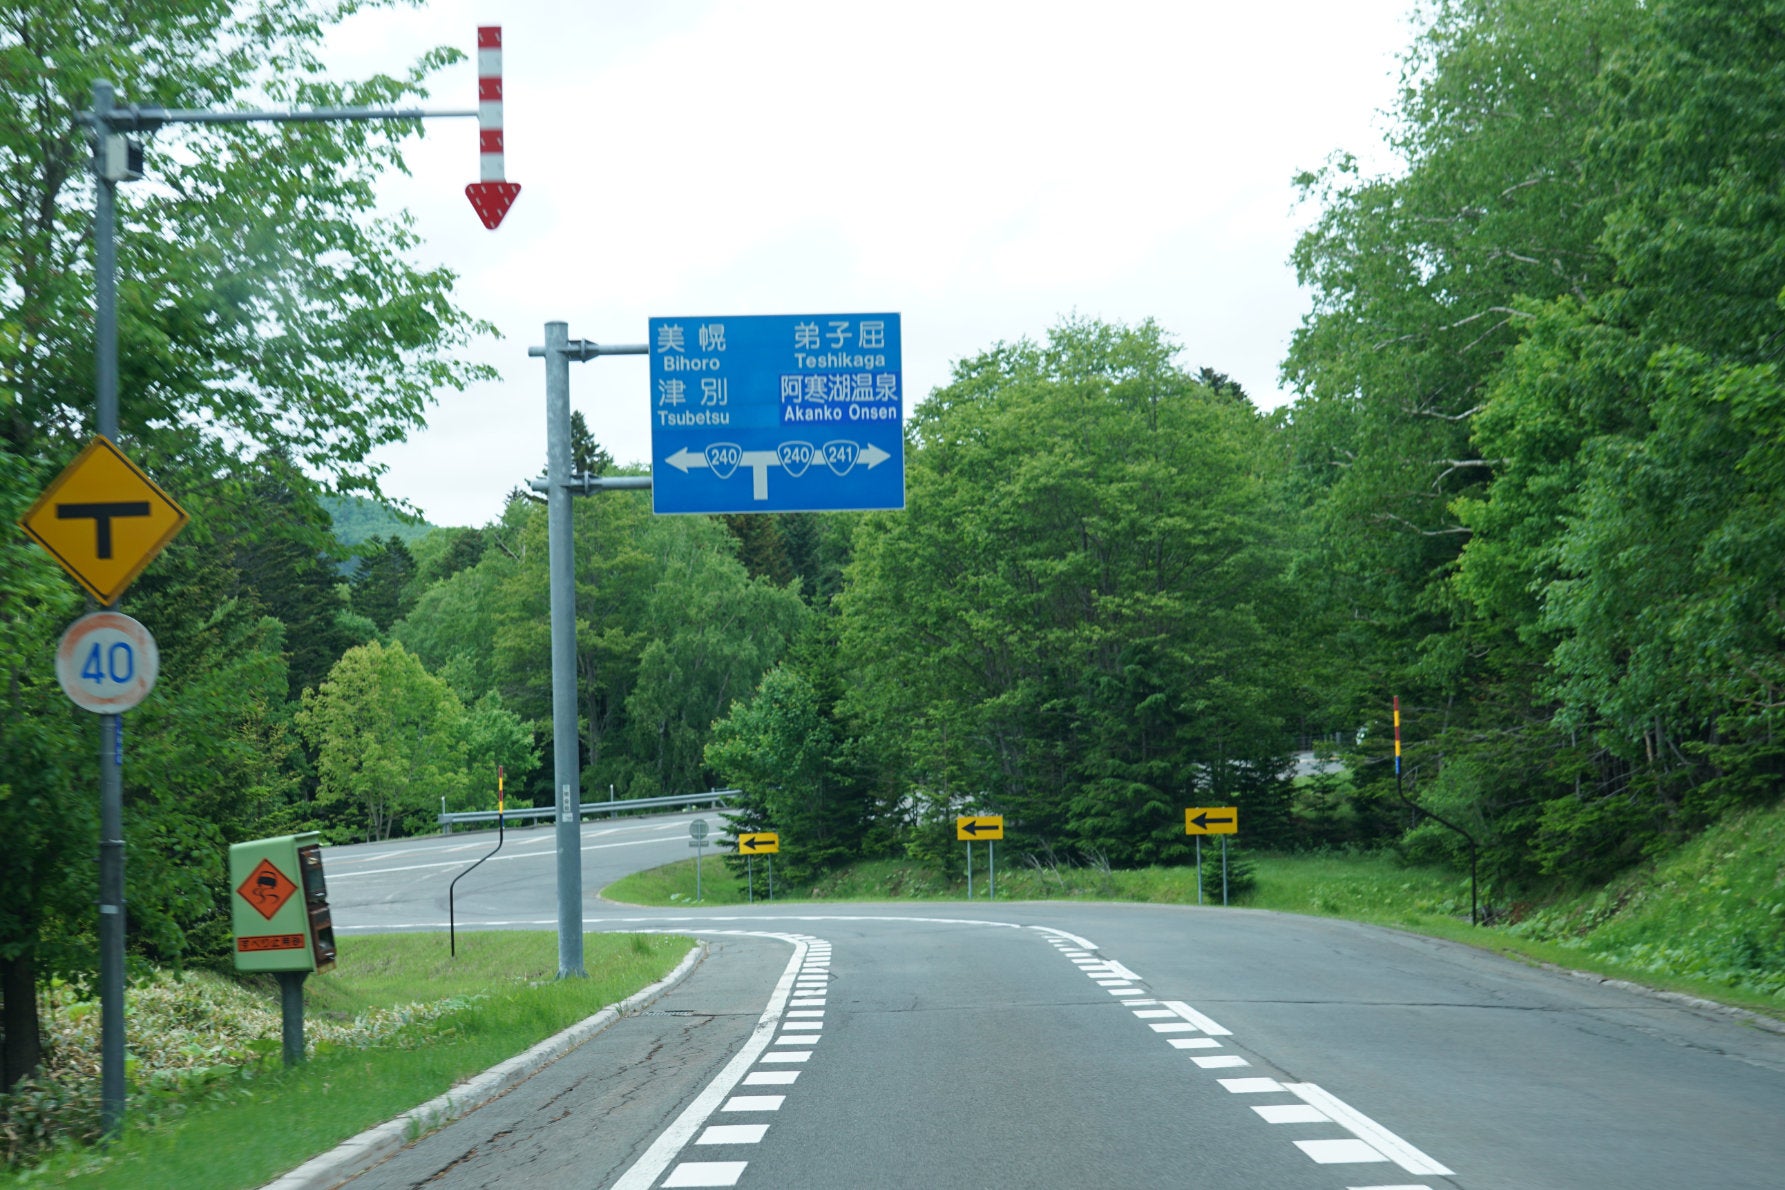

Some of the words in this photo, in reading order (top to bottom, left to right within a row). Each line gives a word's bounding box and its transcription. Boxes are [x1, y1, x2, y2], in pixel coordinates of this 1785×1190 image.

[657, 323, 727, 353] 美幌
[794, 320, 885, 350] 弟子屈
[663, 356, 720, 372] Bihoro
[794, 353, 886, 370] Teshikaga
[658, 377, 728, 407] 津別
[780, 373, 898, 404] 阿寒湖温泉
[657, 410, 730, 426] Tsubetsu
[784, 405, 842, 422] Akanko
[848, 404, 897, 420] Onsen
[711, 448, 737, 466] 240
[783, 447, 809, 464] 240
[829, 446, 853, 463] 241
[81, 641, 134, 684] 40
